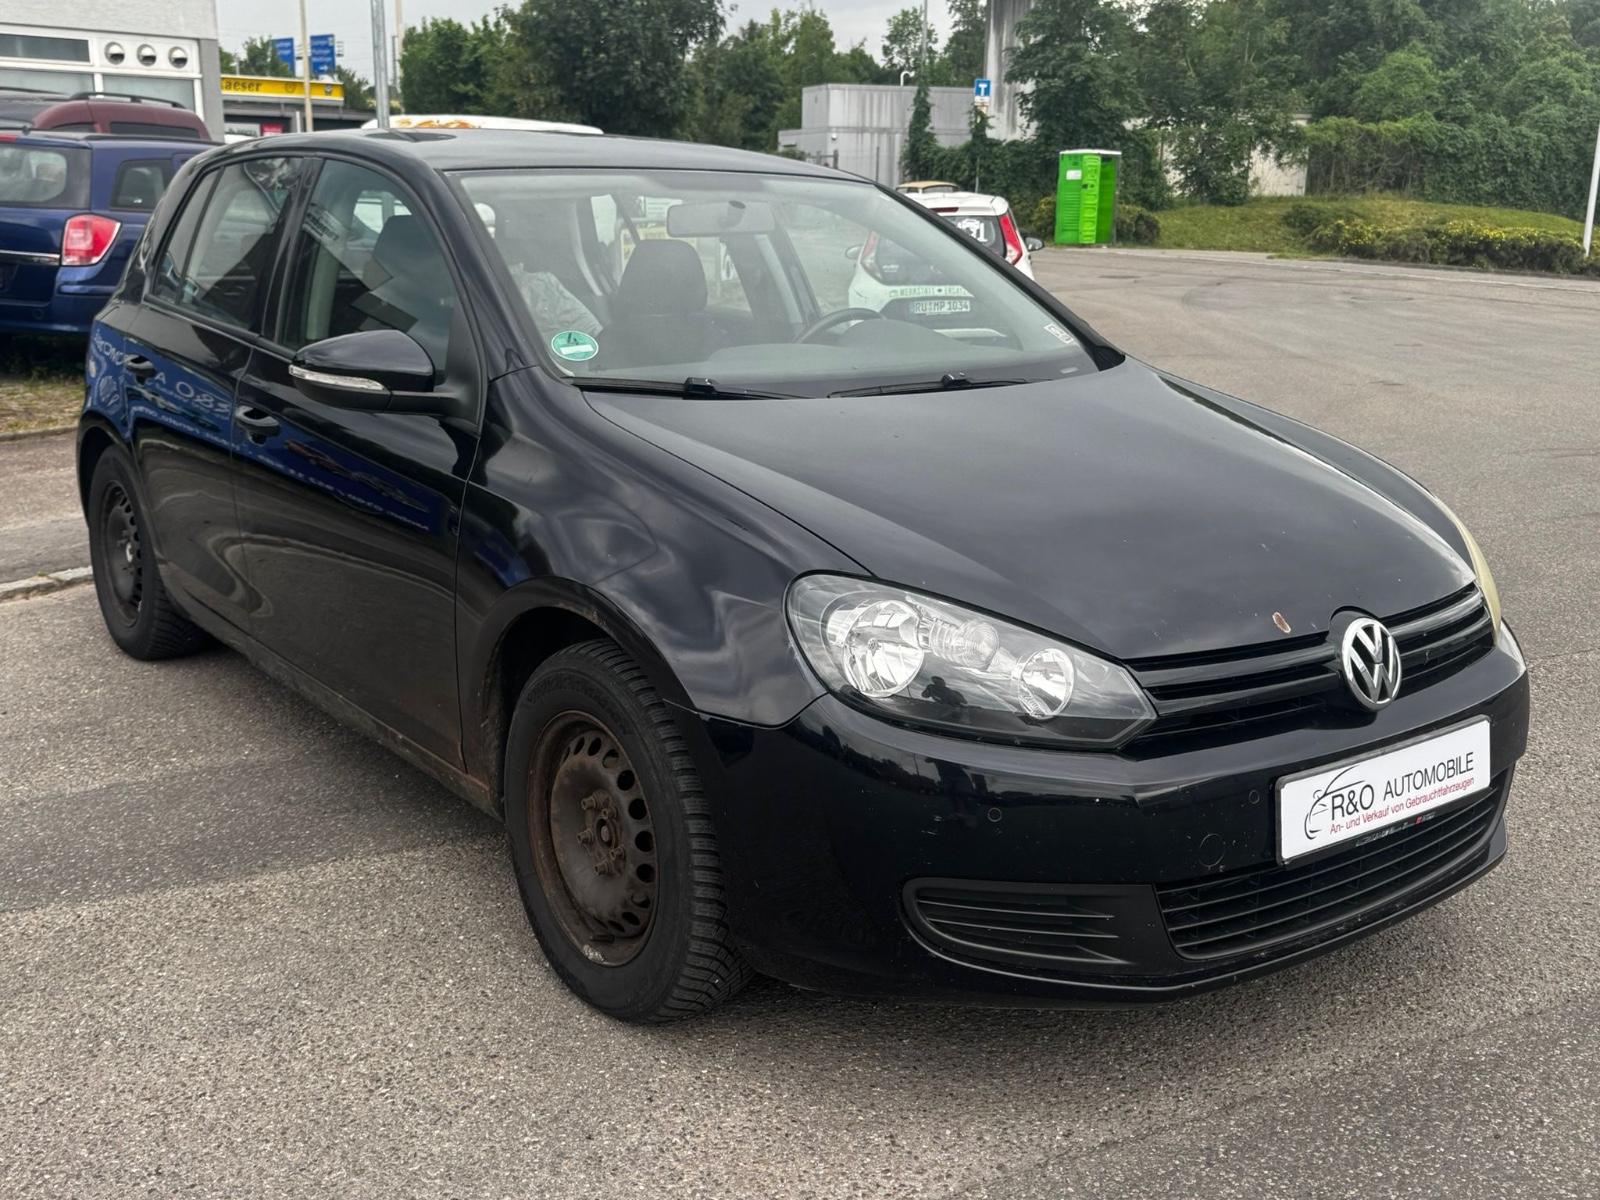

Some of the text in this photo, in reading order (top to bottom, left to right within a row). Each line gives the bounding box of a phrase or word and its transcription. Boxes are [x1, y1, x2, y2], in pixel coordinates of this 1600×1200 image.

[221, 81, 262, 92] aeser
[1331, 752, 1474, 820] R&O AUTOMOBILE
[1330, 823, 1344, 834] An-
[1346, 815, 1361, 830] und
[1361, 806, 1390, 824] Verkauf
[1391, 802, 1404, 814] von
